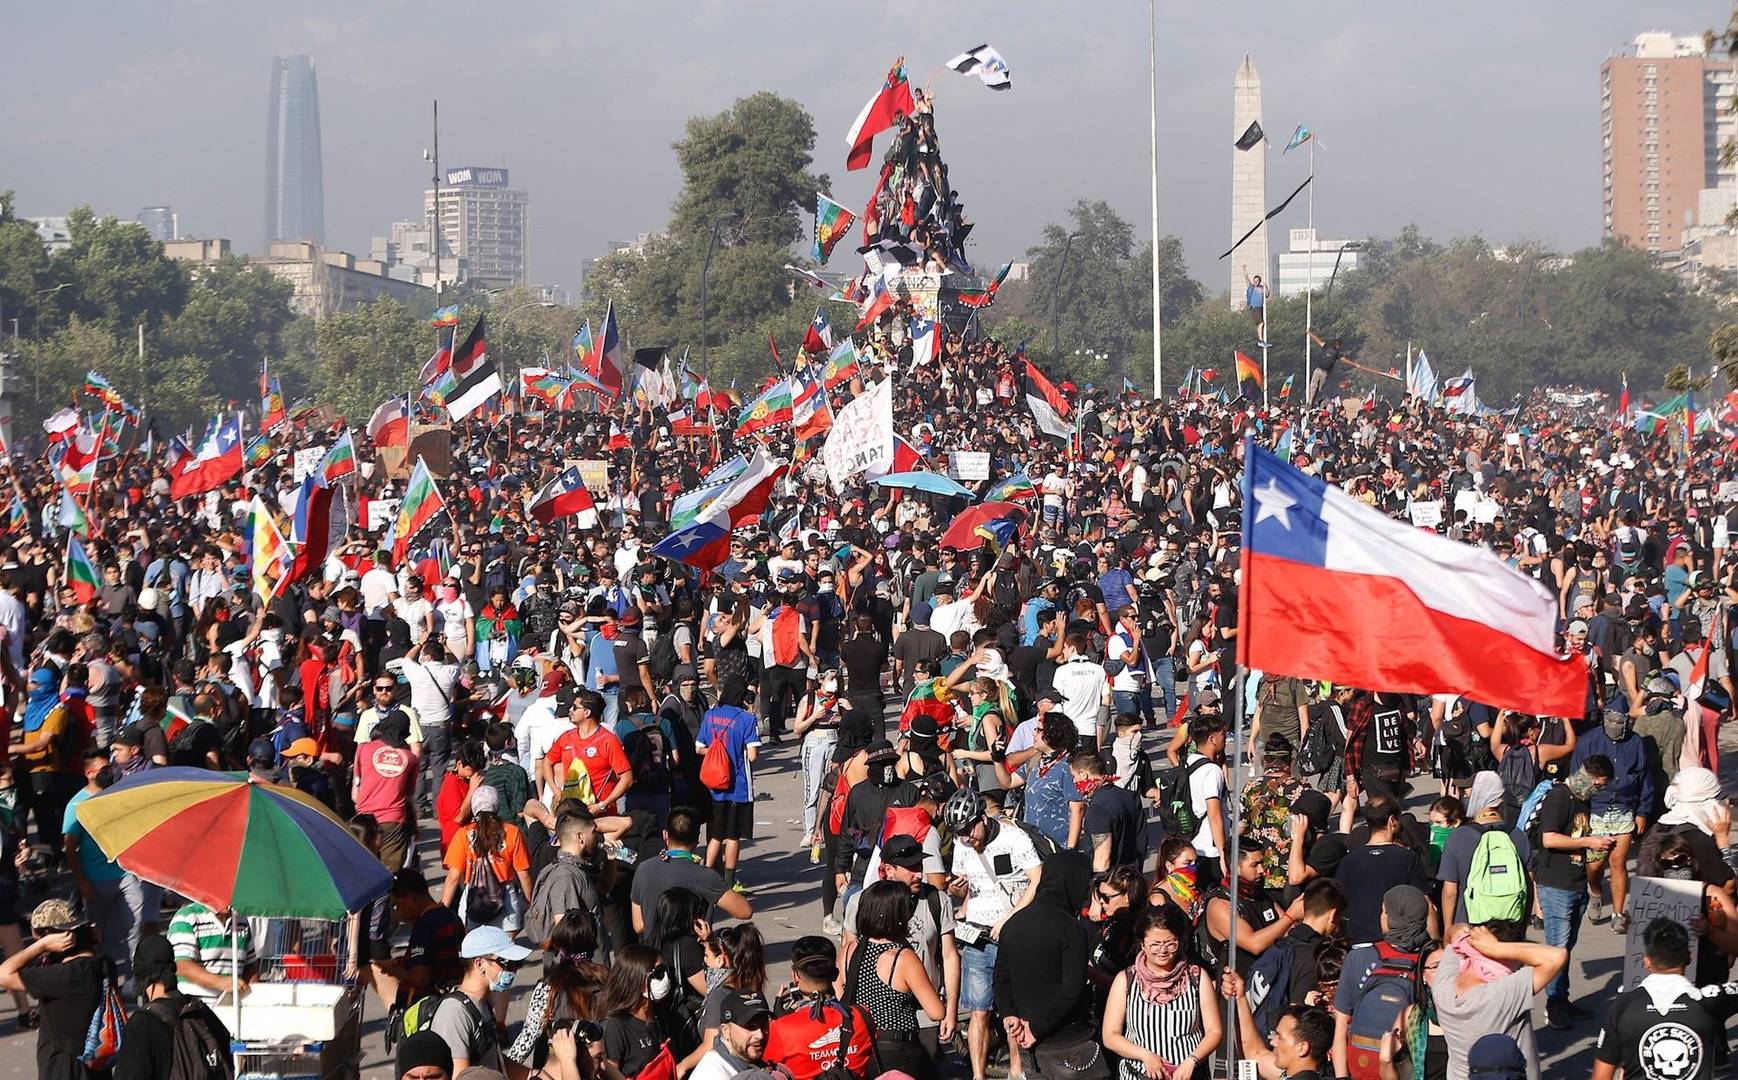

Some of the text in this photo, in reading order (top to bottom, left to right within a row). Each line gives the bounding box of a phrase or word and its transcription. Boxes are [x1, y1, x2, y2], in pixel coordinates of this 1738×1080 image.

[448, 169, 502, 184] WOM WOM
[1292, 231, 1312, 240] IBM
[1383, 717, 1397, 727] BE
[1383, 728, 1399, 738] LIE
[1386, 739, 1399, 749] VE
[1642, 880, 1664, 899] LO
[1643, 1027, 1700, 1058] BLACK SKULL
